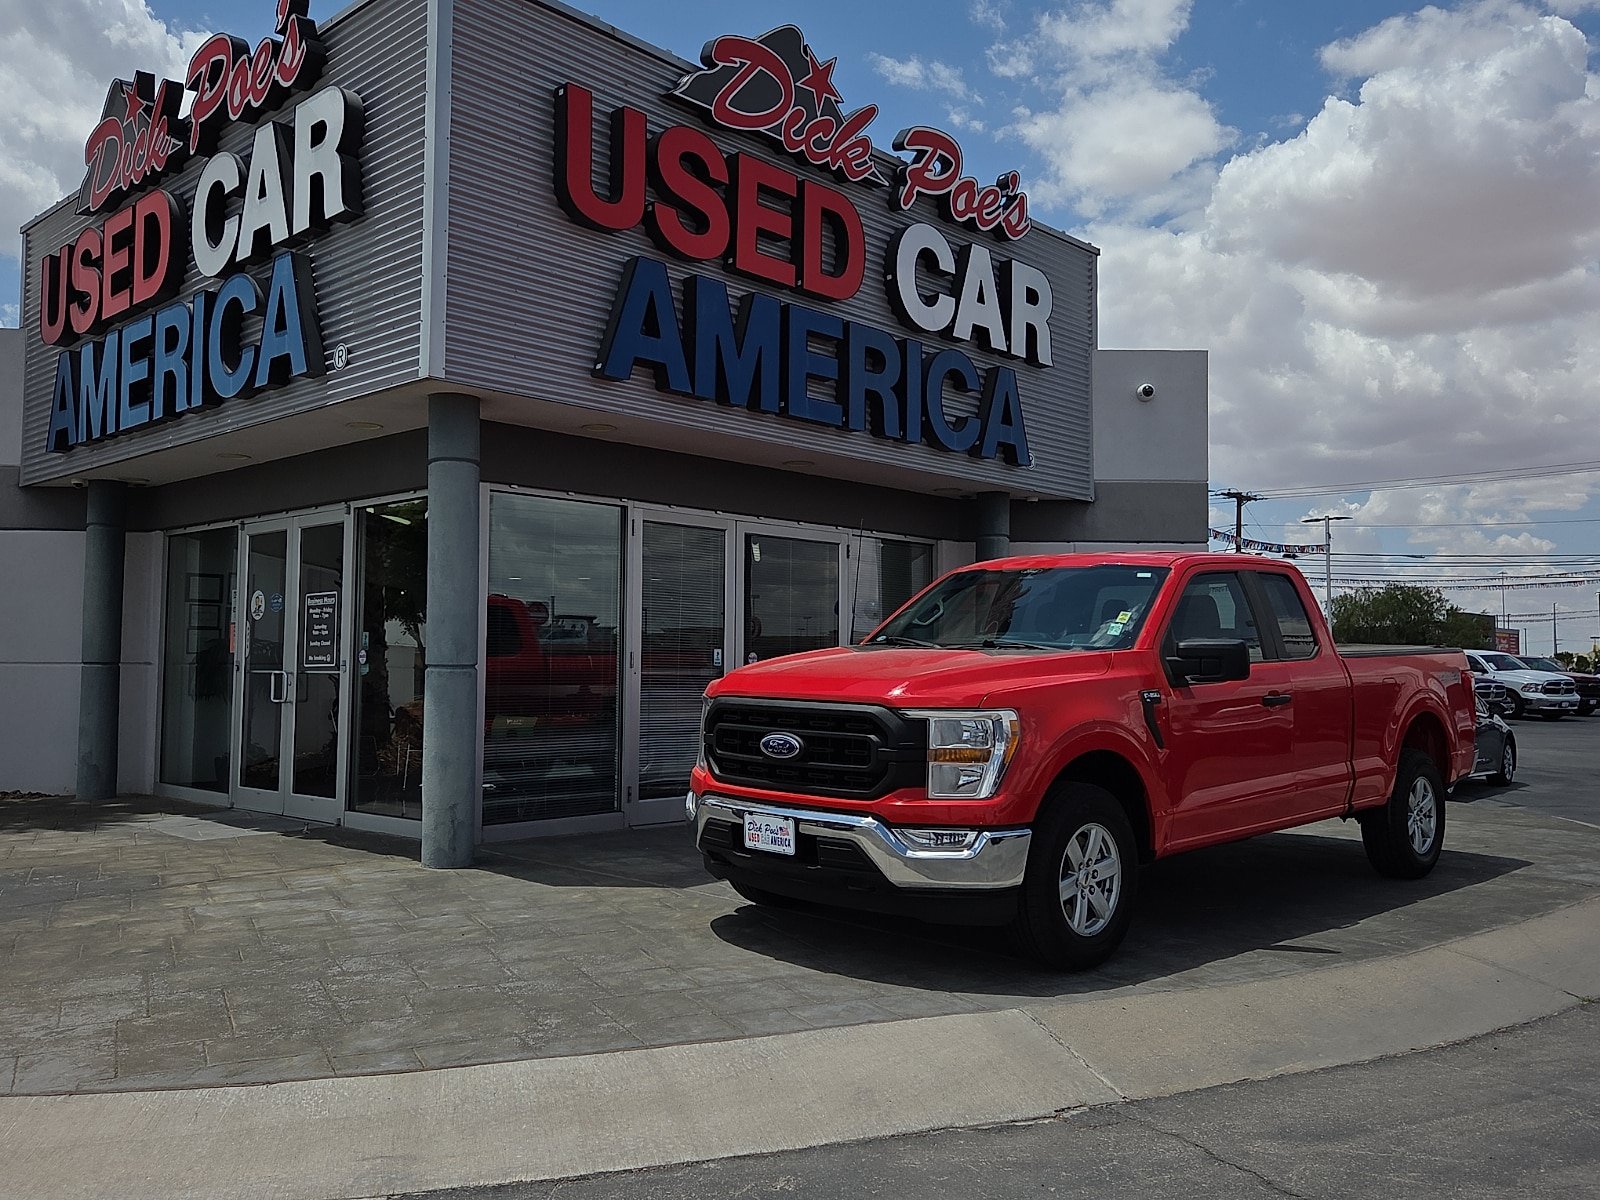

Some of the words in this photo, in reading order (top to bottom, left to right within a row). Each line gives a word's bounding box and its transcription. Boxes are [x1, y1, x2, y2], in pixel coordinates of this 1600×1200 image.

[85, 78, 173, 211] Dick
[186, 0, 306, 155] Poe's
[711, 35, 879, 181] Dick
[901, 126, 1031, 240] Poe's
[40, 189, 172, 346] USED
[192, 85, 346, 278] CAR
[564, 82, 867, 300] USED
[895, 222, 1054, 368] CAR
[46, 250, 309, 453] AMERICA
[602, 255, 1031, 467] AMERICA
[747, 821, 762, 833] Dick
[768, 739, 790, 754] Ford
[770, 834, 792, 849] AMERICA
